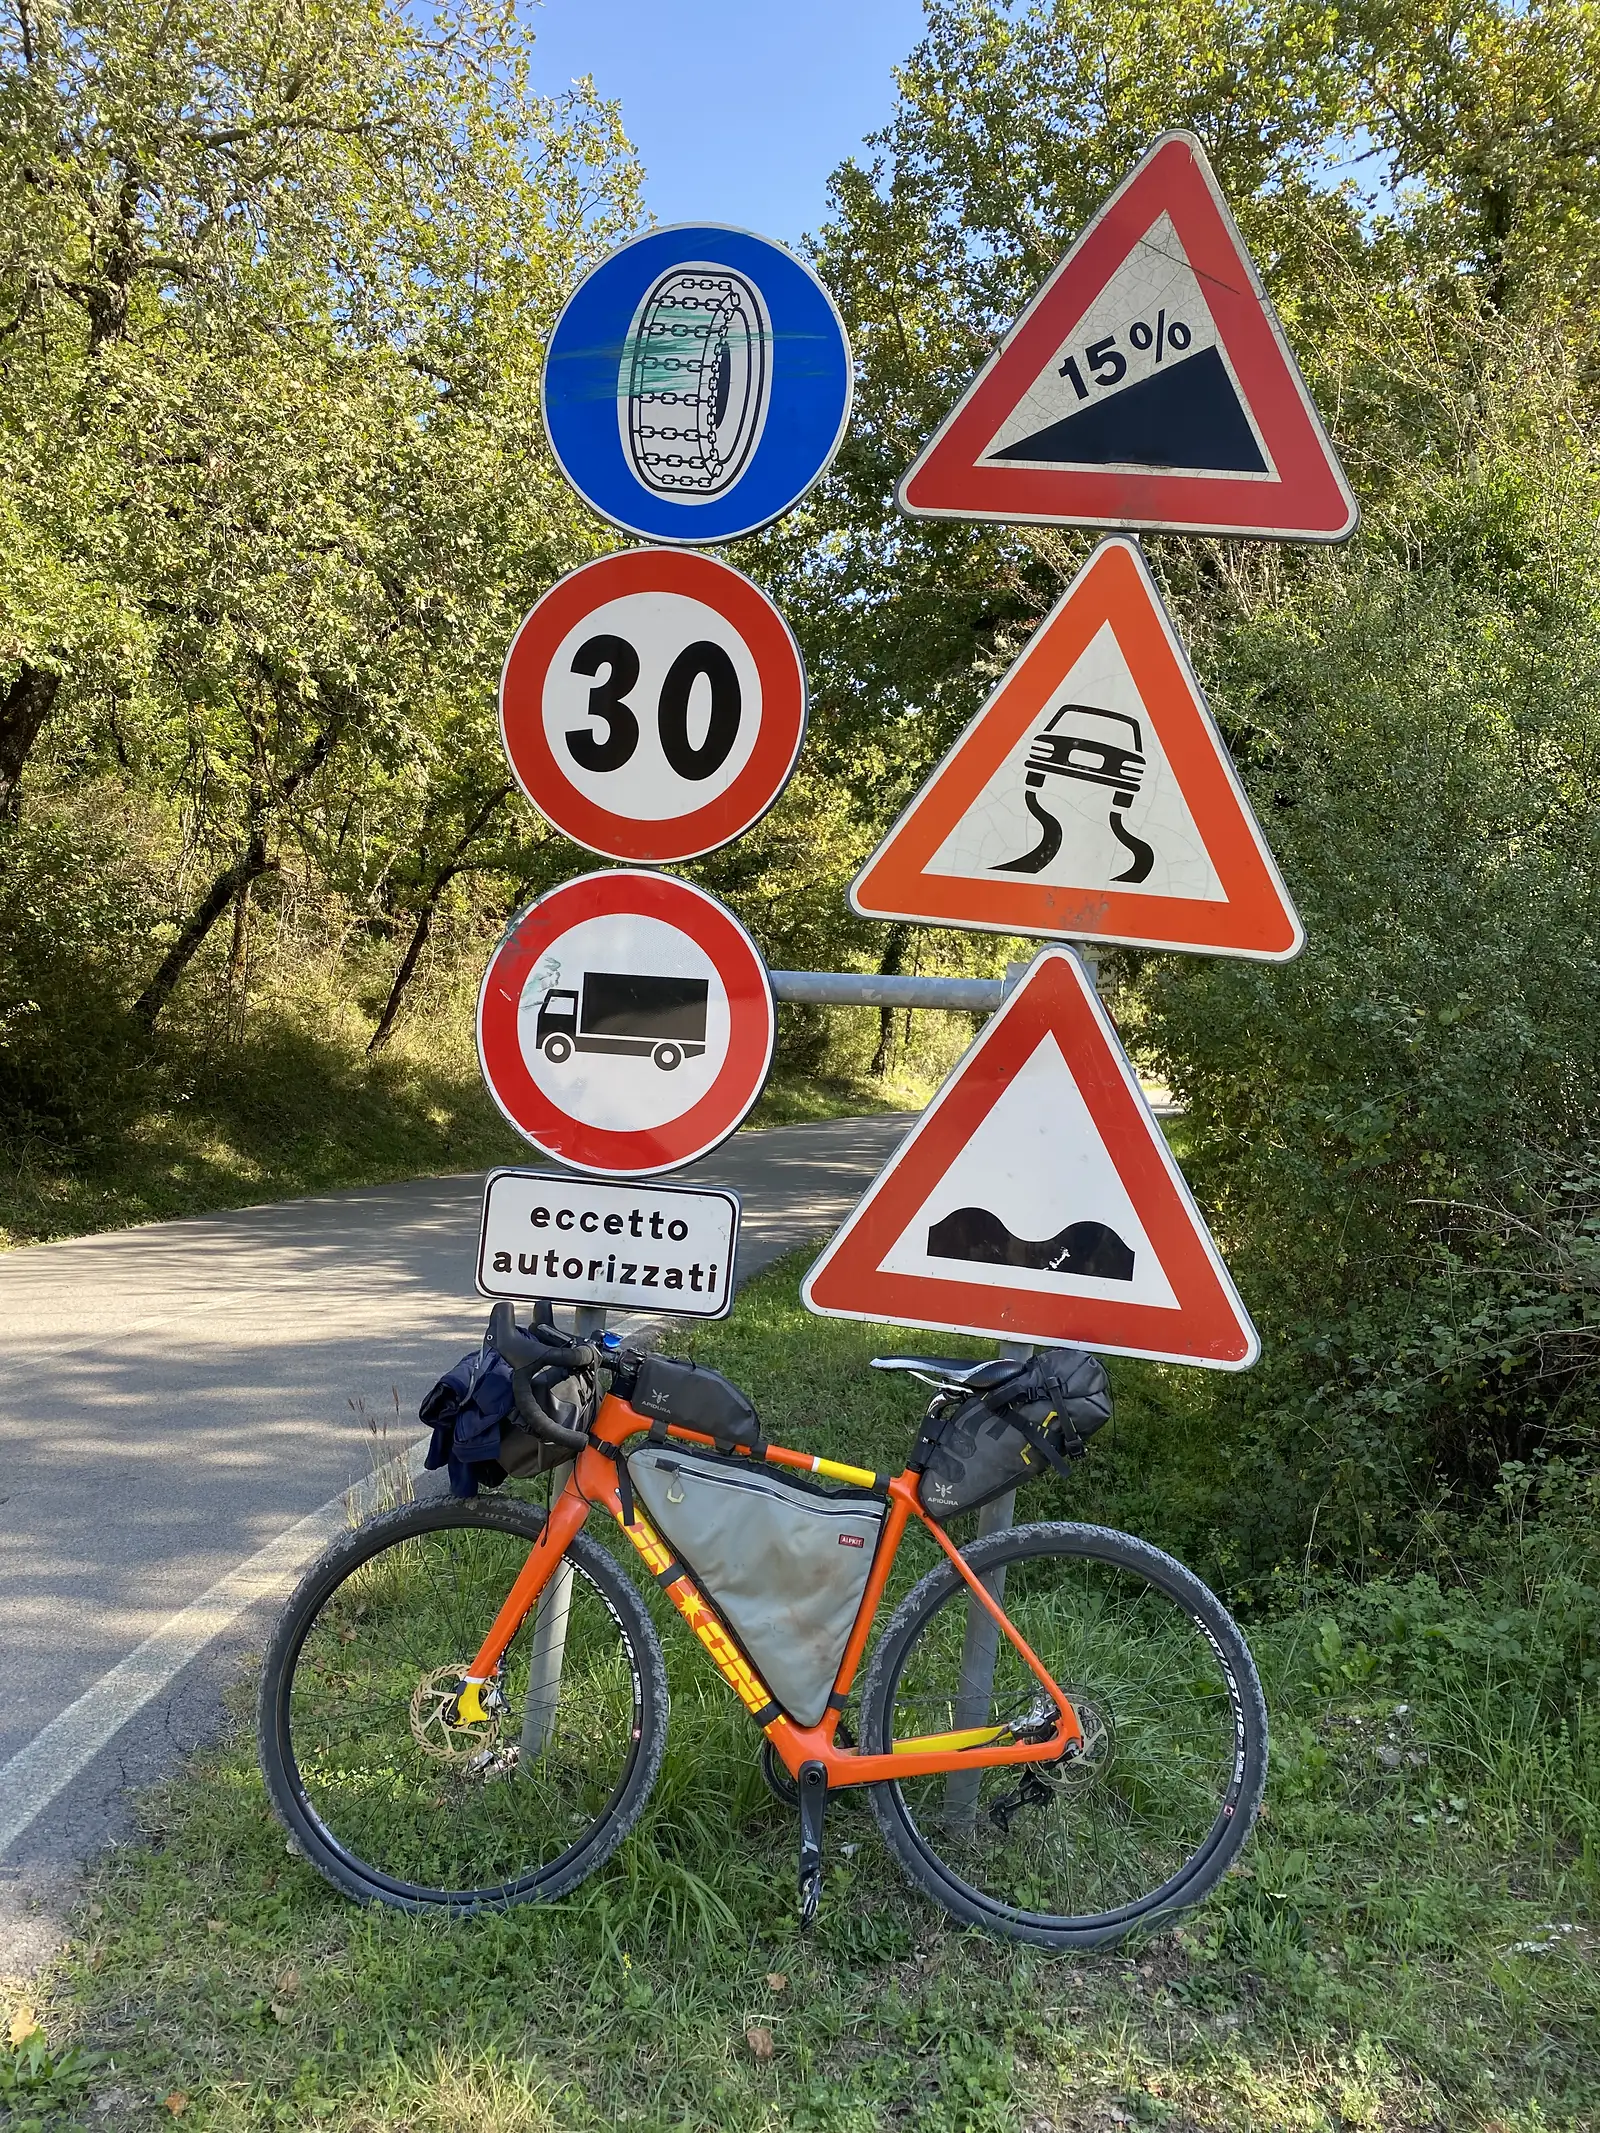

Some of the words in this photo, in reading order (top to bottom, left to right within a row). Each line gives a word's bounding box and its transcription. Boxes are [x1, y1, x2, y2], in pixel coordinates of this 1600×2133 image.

[1058, 308, 1192, 400] 15%
[565, 634, 742, 781] 30
[530, 1206, 689, 1241] eccetto
[492, 1249, 718, 1293] autorizzati
[641, 1400, 671, 1415] APIDURA
[927, 1496, 959, 1506] APIDURA
